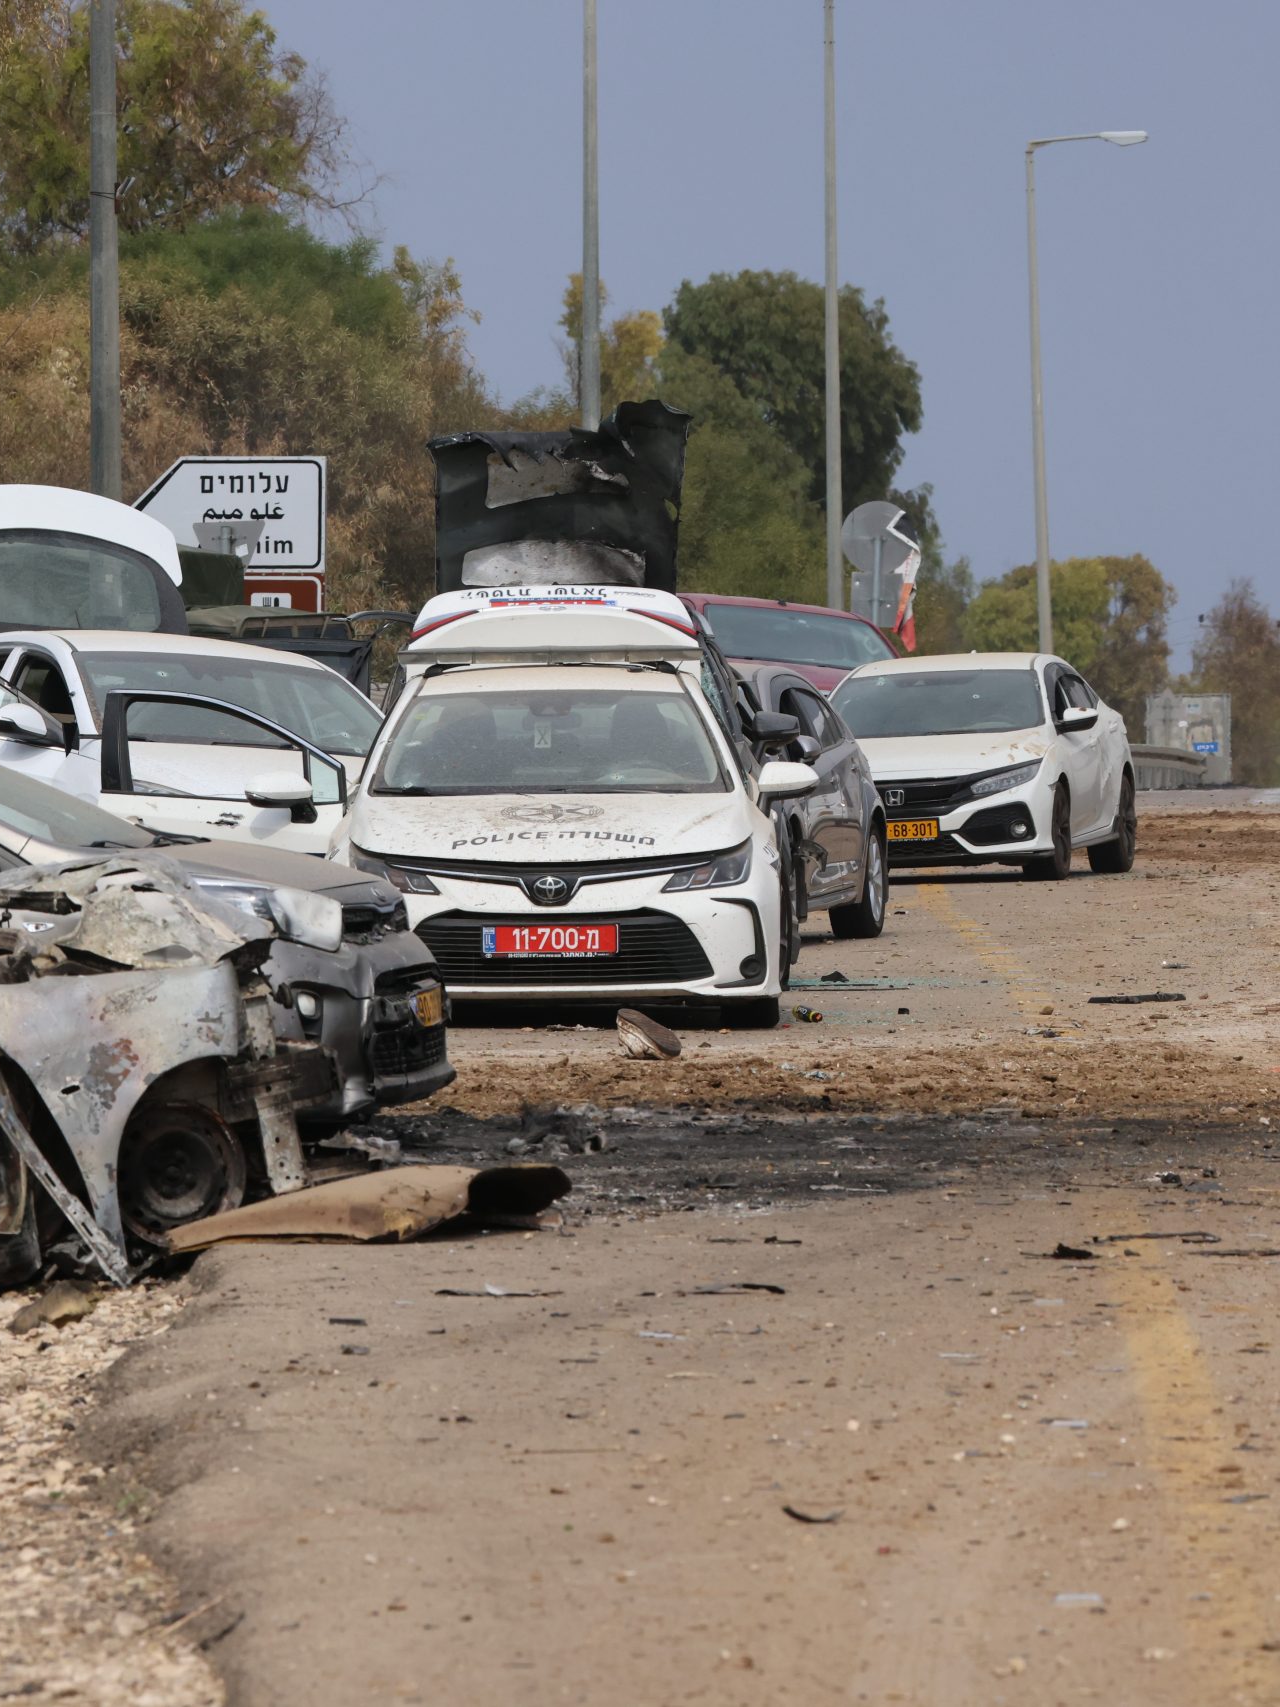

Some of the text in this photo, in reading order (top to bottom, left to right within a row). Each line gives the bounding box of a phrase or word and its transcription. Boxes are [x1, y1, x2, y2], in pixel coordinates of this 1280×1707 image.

[199, 471, 289, 494] עלומים
[451, 831, 656, 850] POLICE משטרה
